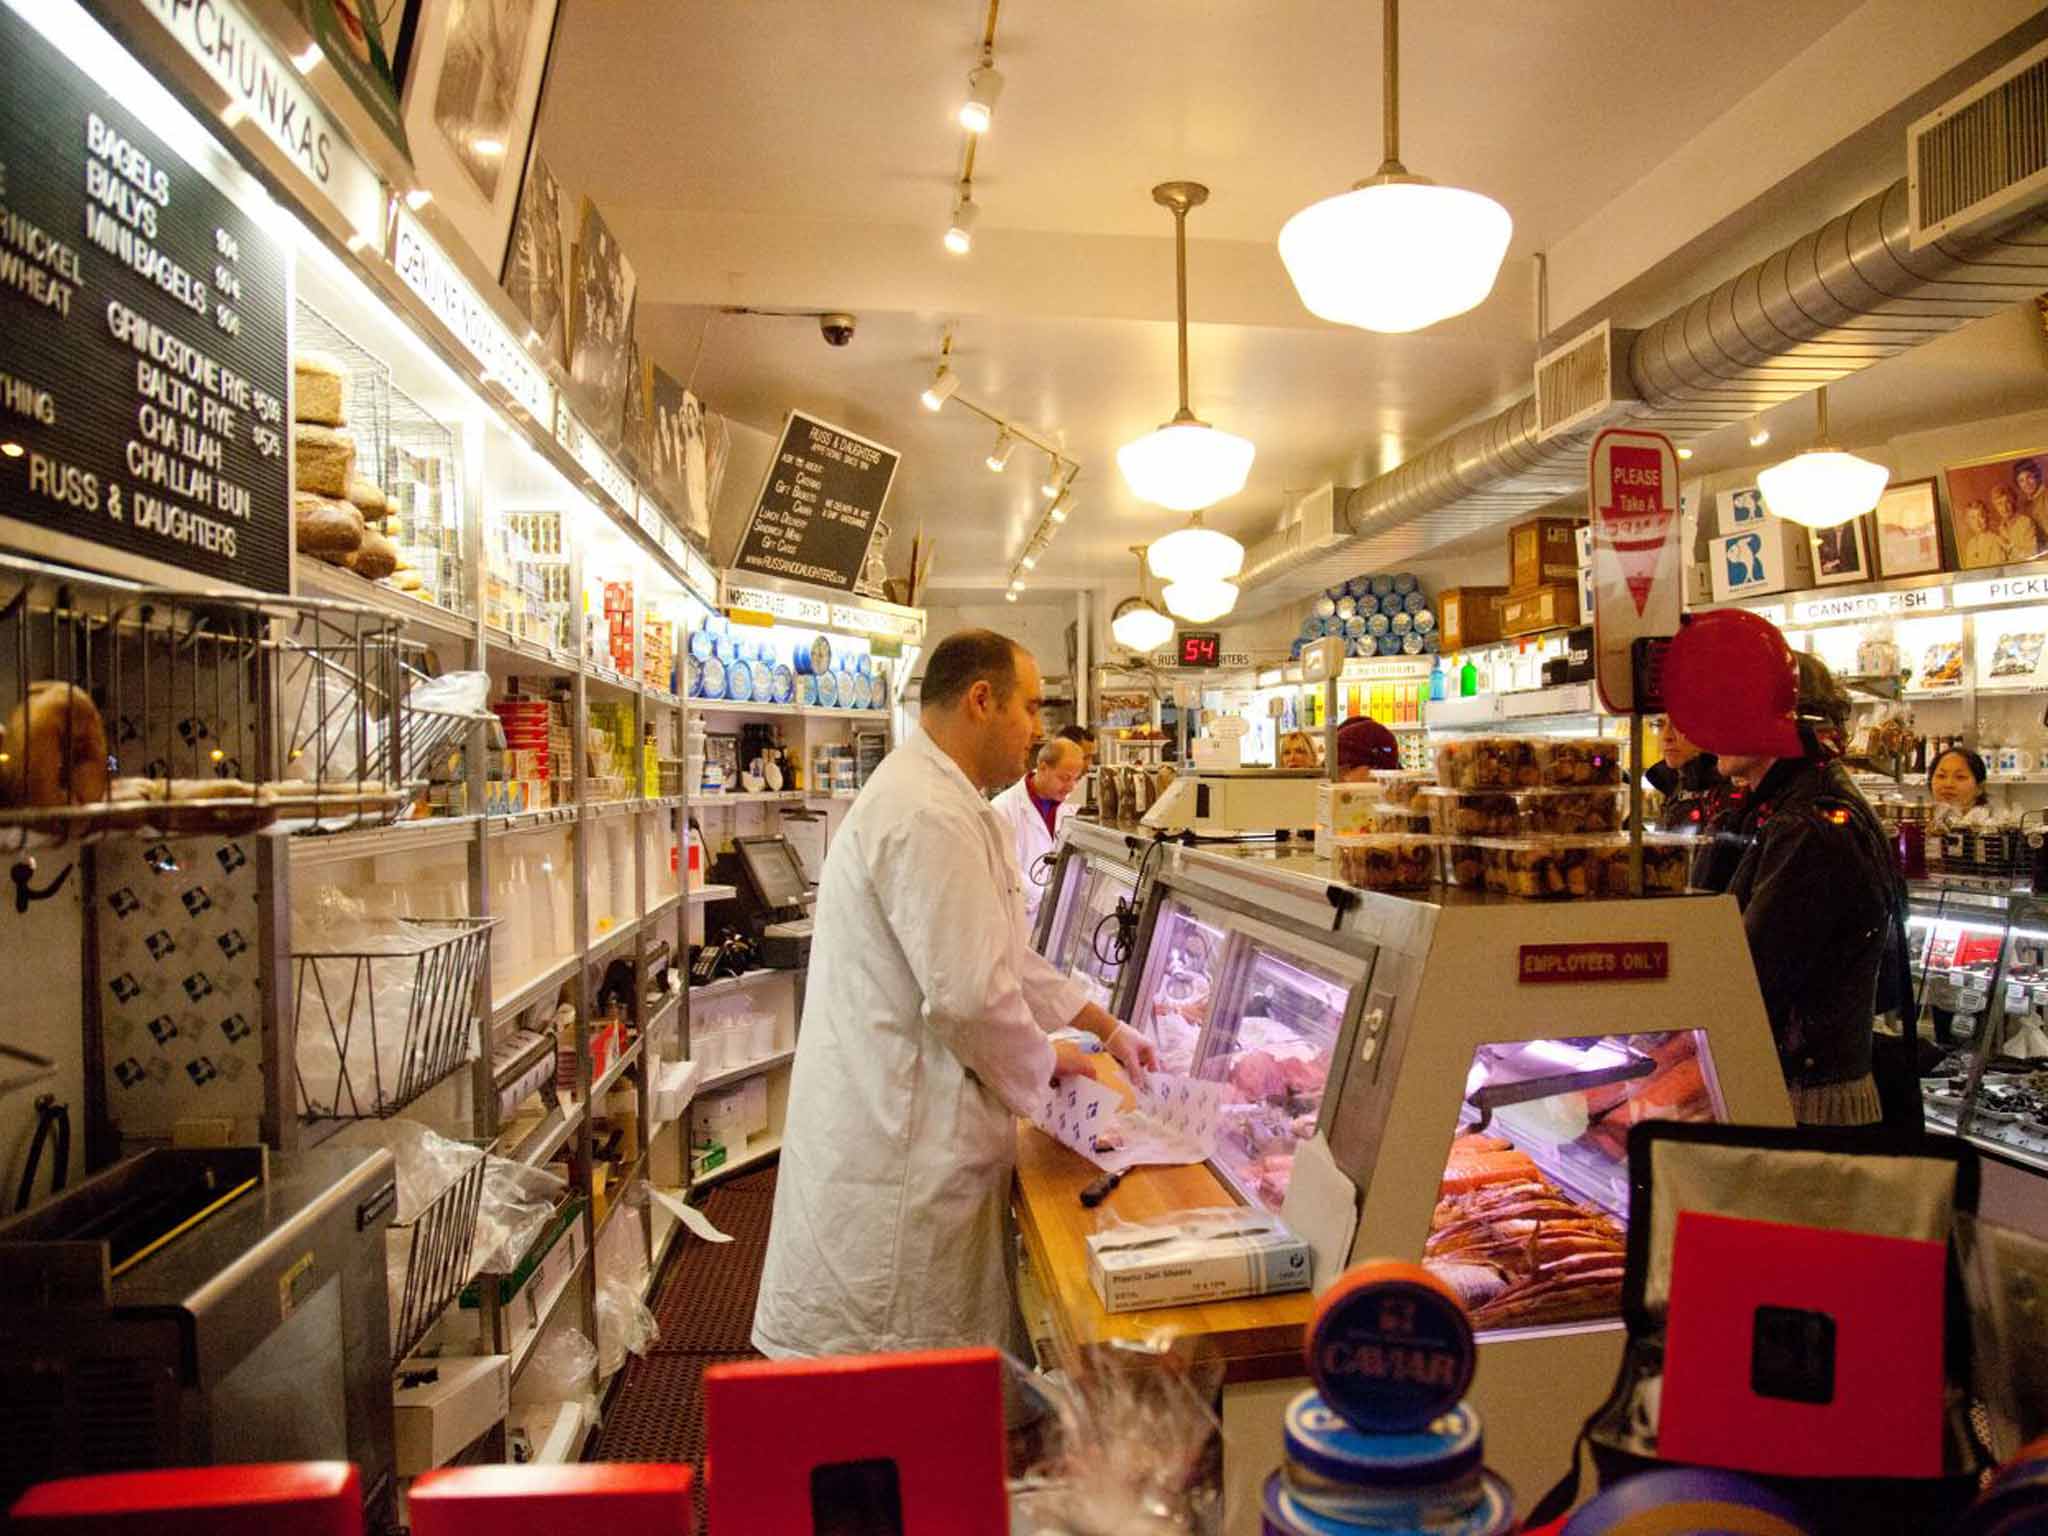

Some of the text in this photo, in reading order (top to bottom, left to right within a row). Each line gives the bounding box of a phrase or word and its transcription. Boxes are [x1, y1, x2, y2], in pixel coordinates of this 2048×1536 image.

[86, 157, 157, 239] BIALYS
[88, 112, 170, 207] BAGELS
[134, 237, 206, 315] BAGELS
[107, 300, 221, 394] GRINDSTONE
[221, 368, 250, 412] RYE
[137, 358, 198, 420] BALTIC
[203, 396, 236, 439] RYE
[30, 455, 237, 558] RUSS & DAUGHTERS
[126, 441, 250, 521] CHALLAH BUN
[1613, 466, 1660, 487] PLEASE
[1619, 494, 1657, 513] Take A
[1807, 597, 1880, 620] CANNED
[1889, 591, 1928, 610] FISH
[1989, 578, 2048, 598] PICKL
[1184, 638, 1214, 661] 54
[1524, 951, 1663, 973] EMPLOYEES ONLY
